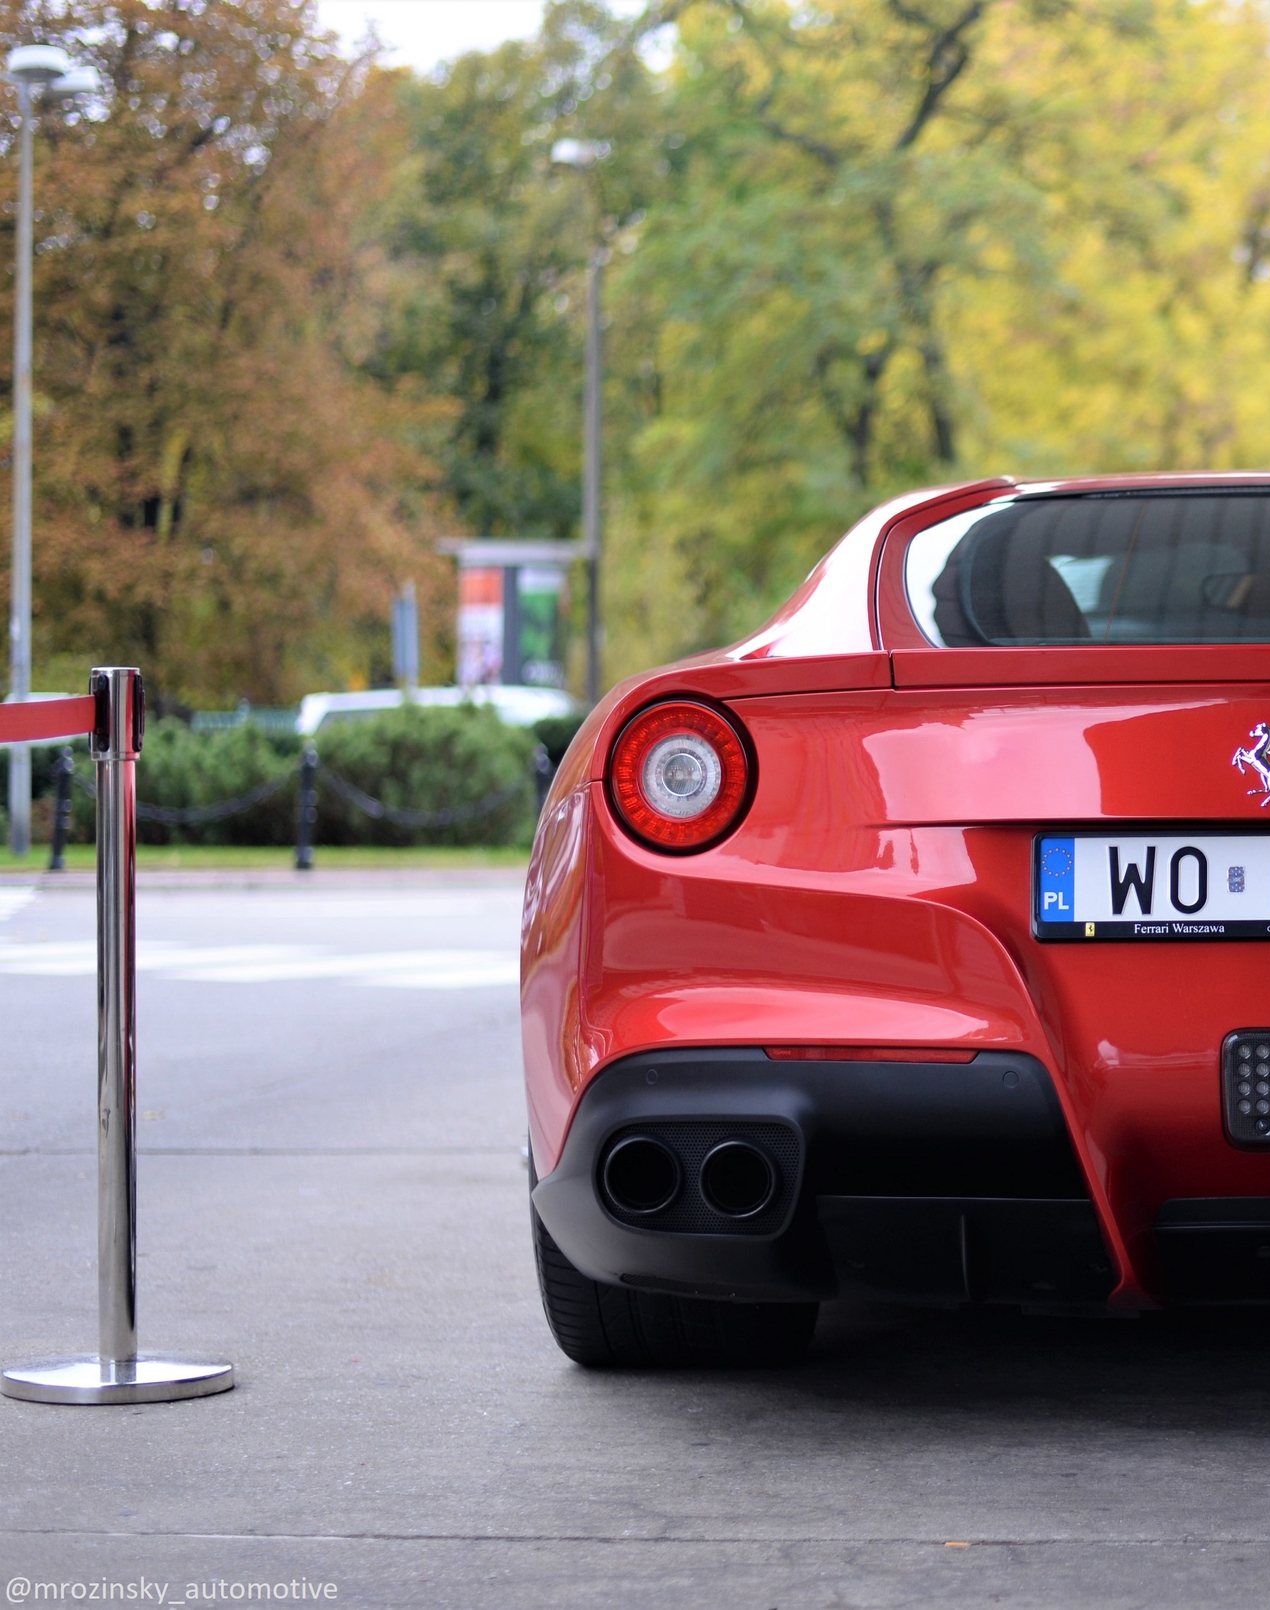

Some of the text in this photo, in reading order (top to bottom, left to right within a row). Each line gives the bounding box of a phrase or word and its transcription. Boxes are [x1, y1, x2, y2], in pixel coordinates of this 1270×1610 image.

[1043, 891, 1070, 910] PL
[1134, 923, 1226, 934] Ferrari Warszawa
